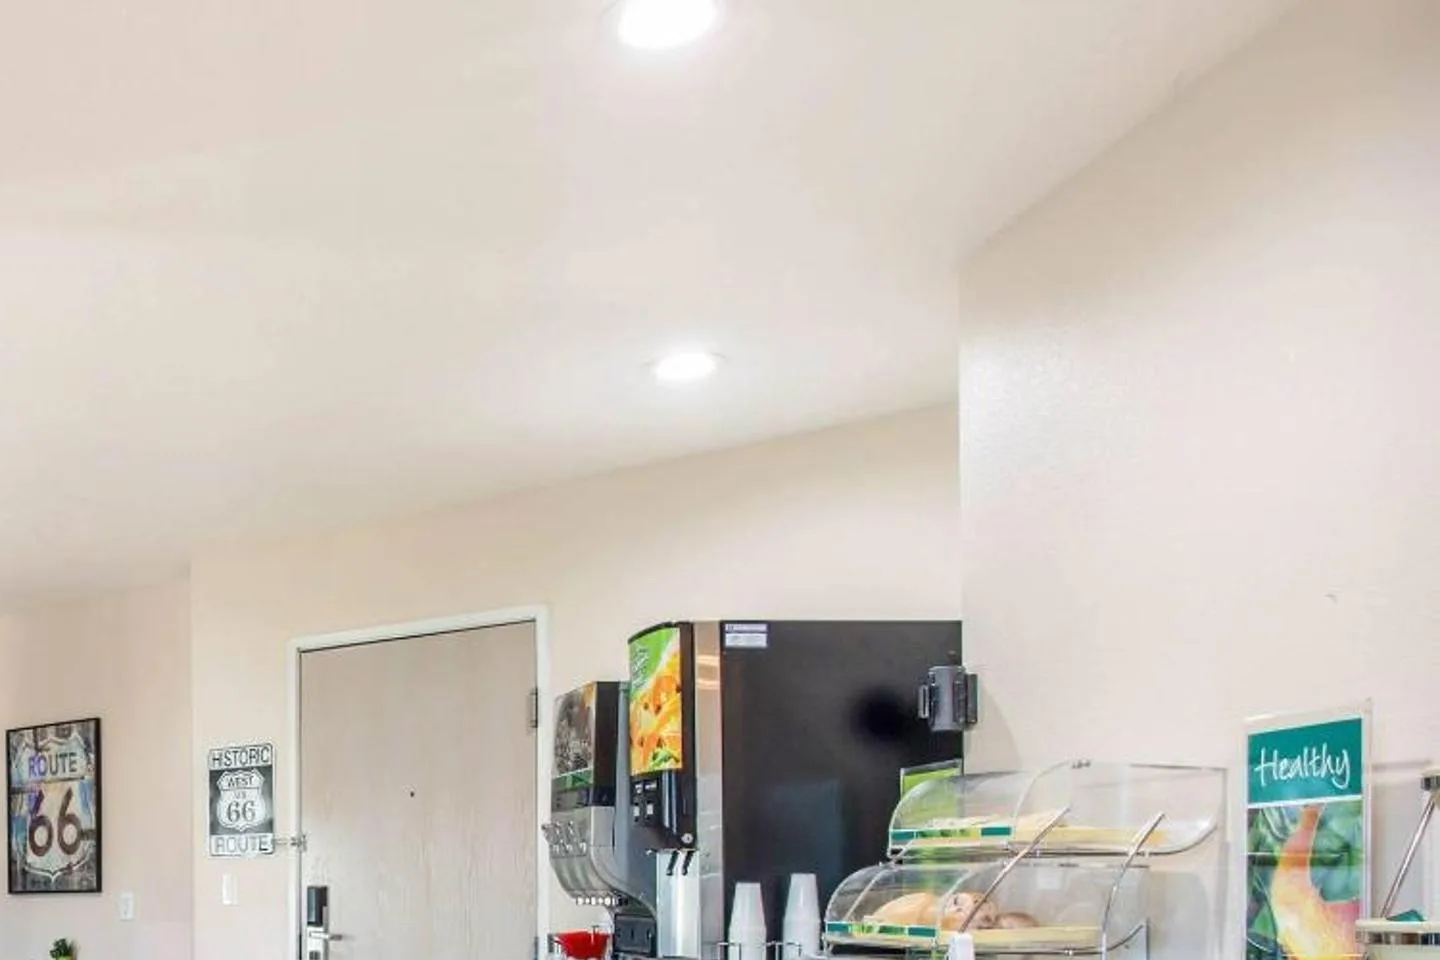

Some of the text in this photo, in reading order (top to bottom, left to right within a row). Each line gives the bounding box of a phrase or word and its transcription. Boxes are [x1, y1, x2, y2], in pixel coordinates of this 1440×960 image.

[28, 752, 78, 777] ROUTE
[212, 746, 270, 768] HISTORIC
[1253, 742, 1351, 790] Healthy
[28, 786, 83, 857] 66
[227, 801, 257, 822] 66
[214, 836, 270, 853] ROUTE
